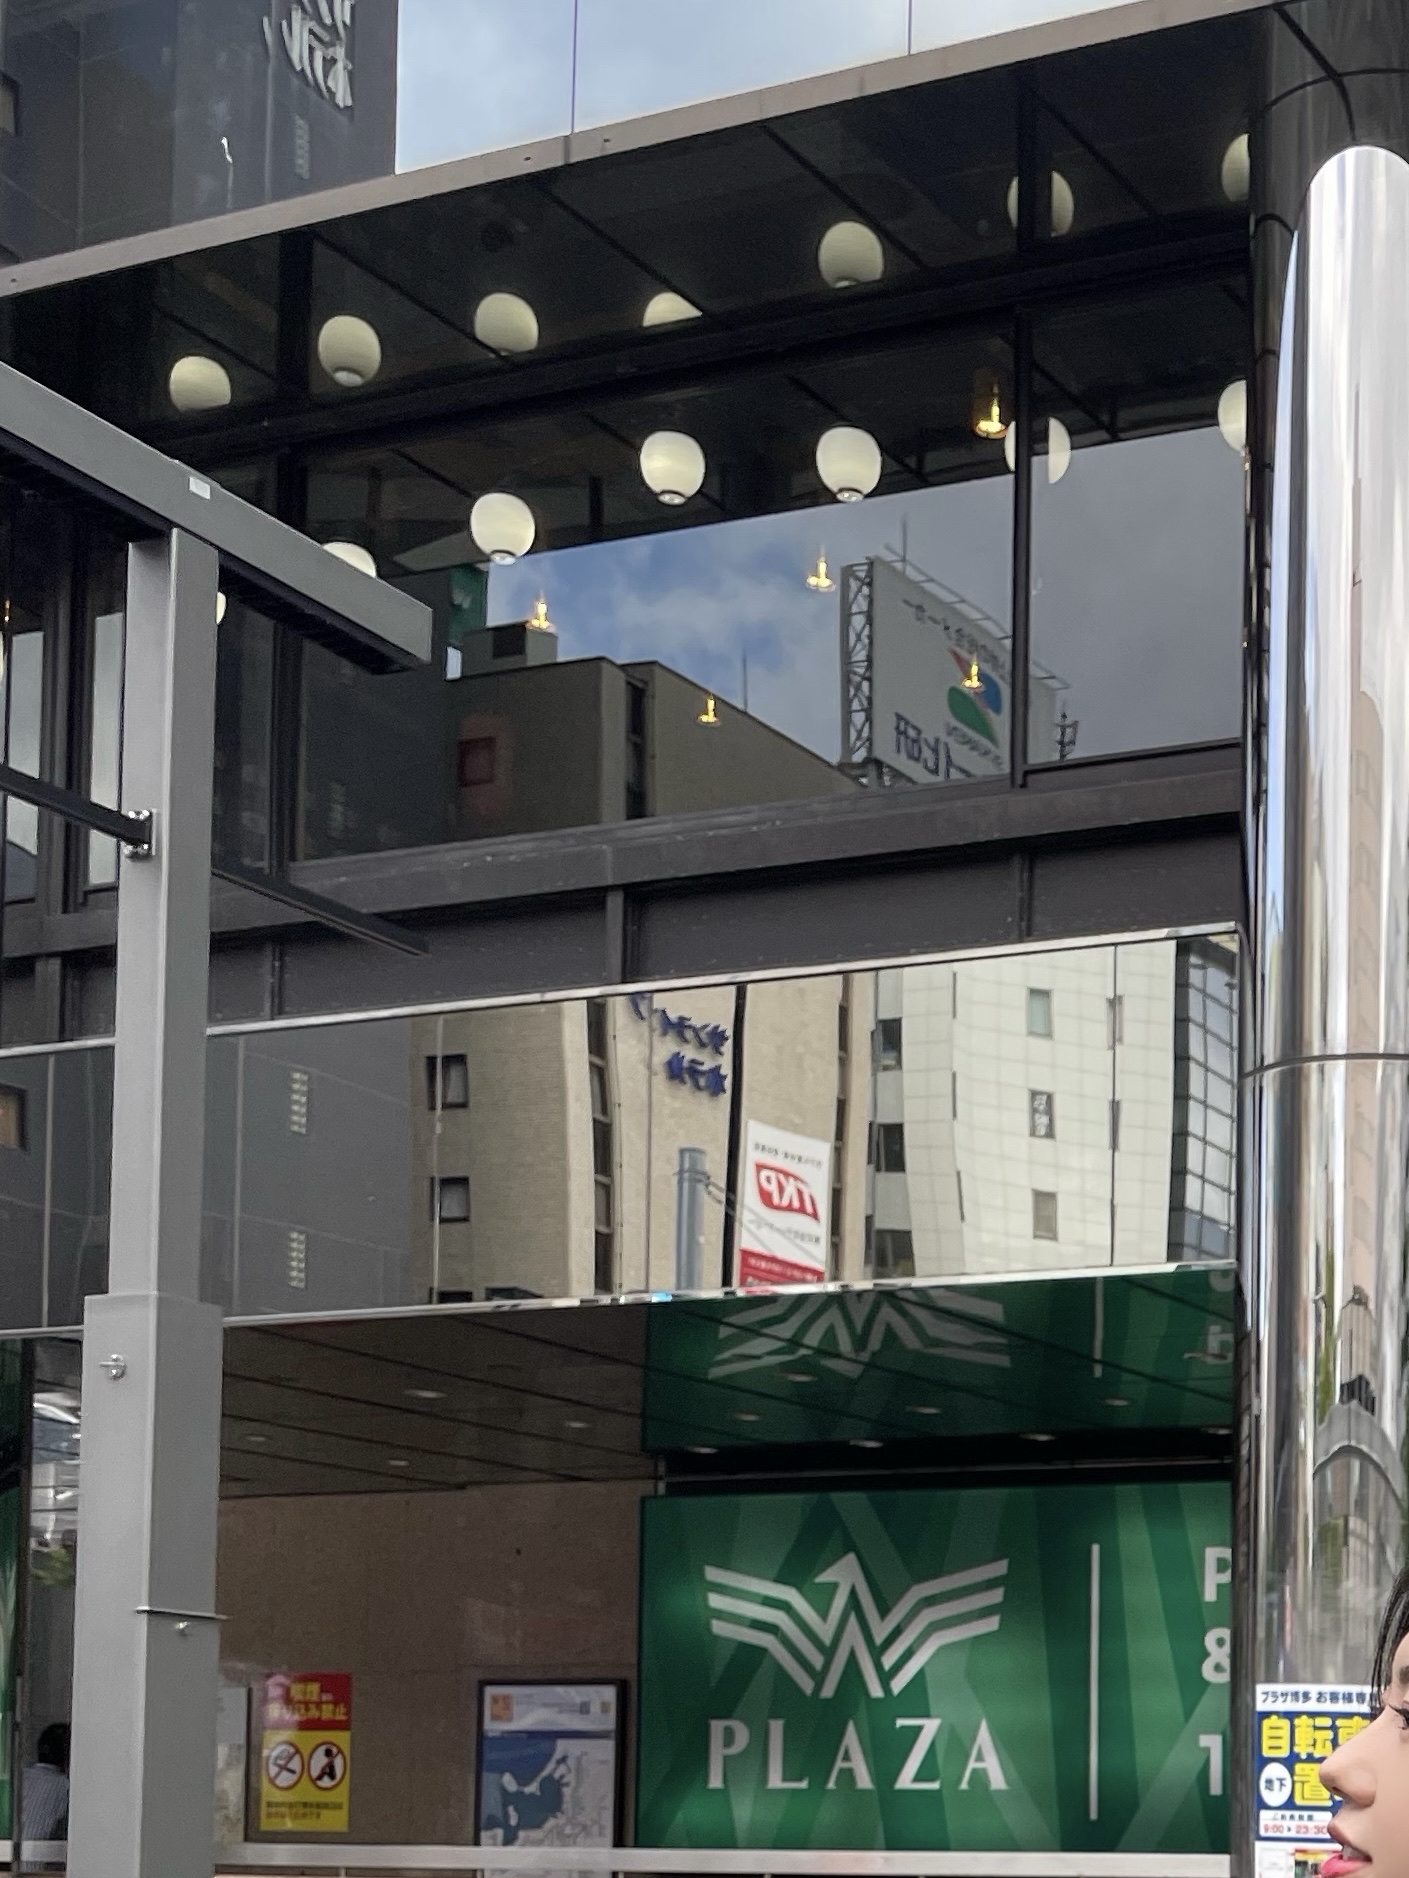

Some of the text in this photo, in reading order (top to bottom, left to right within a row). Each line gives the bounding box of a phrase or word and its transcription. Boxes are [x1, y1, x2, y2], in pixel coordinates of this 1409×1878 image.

[1260, 1690, 1312, 1704] プラザ博多
[705, 1715, 1011, 1792] PLAZA
[1264, 1777, 1288, 1793] 地下
[1293, 1761, 1342, 1808] 置
